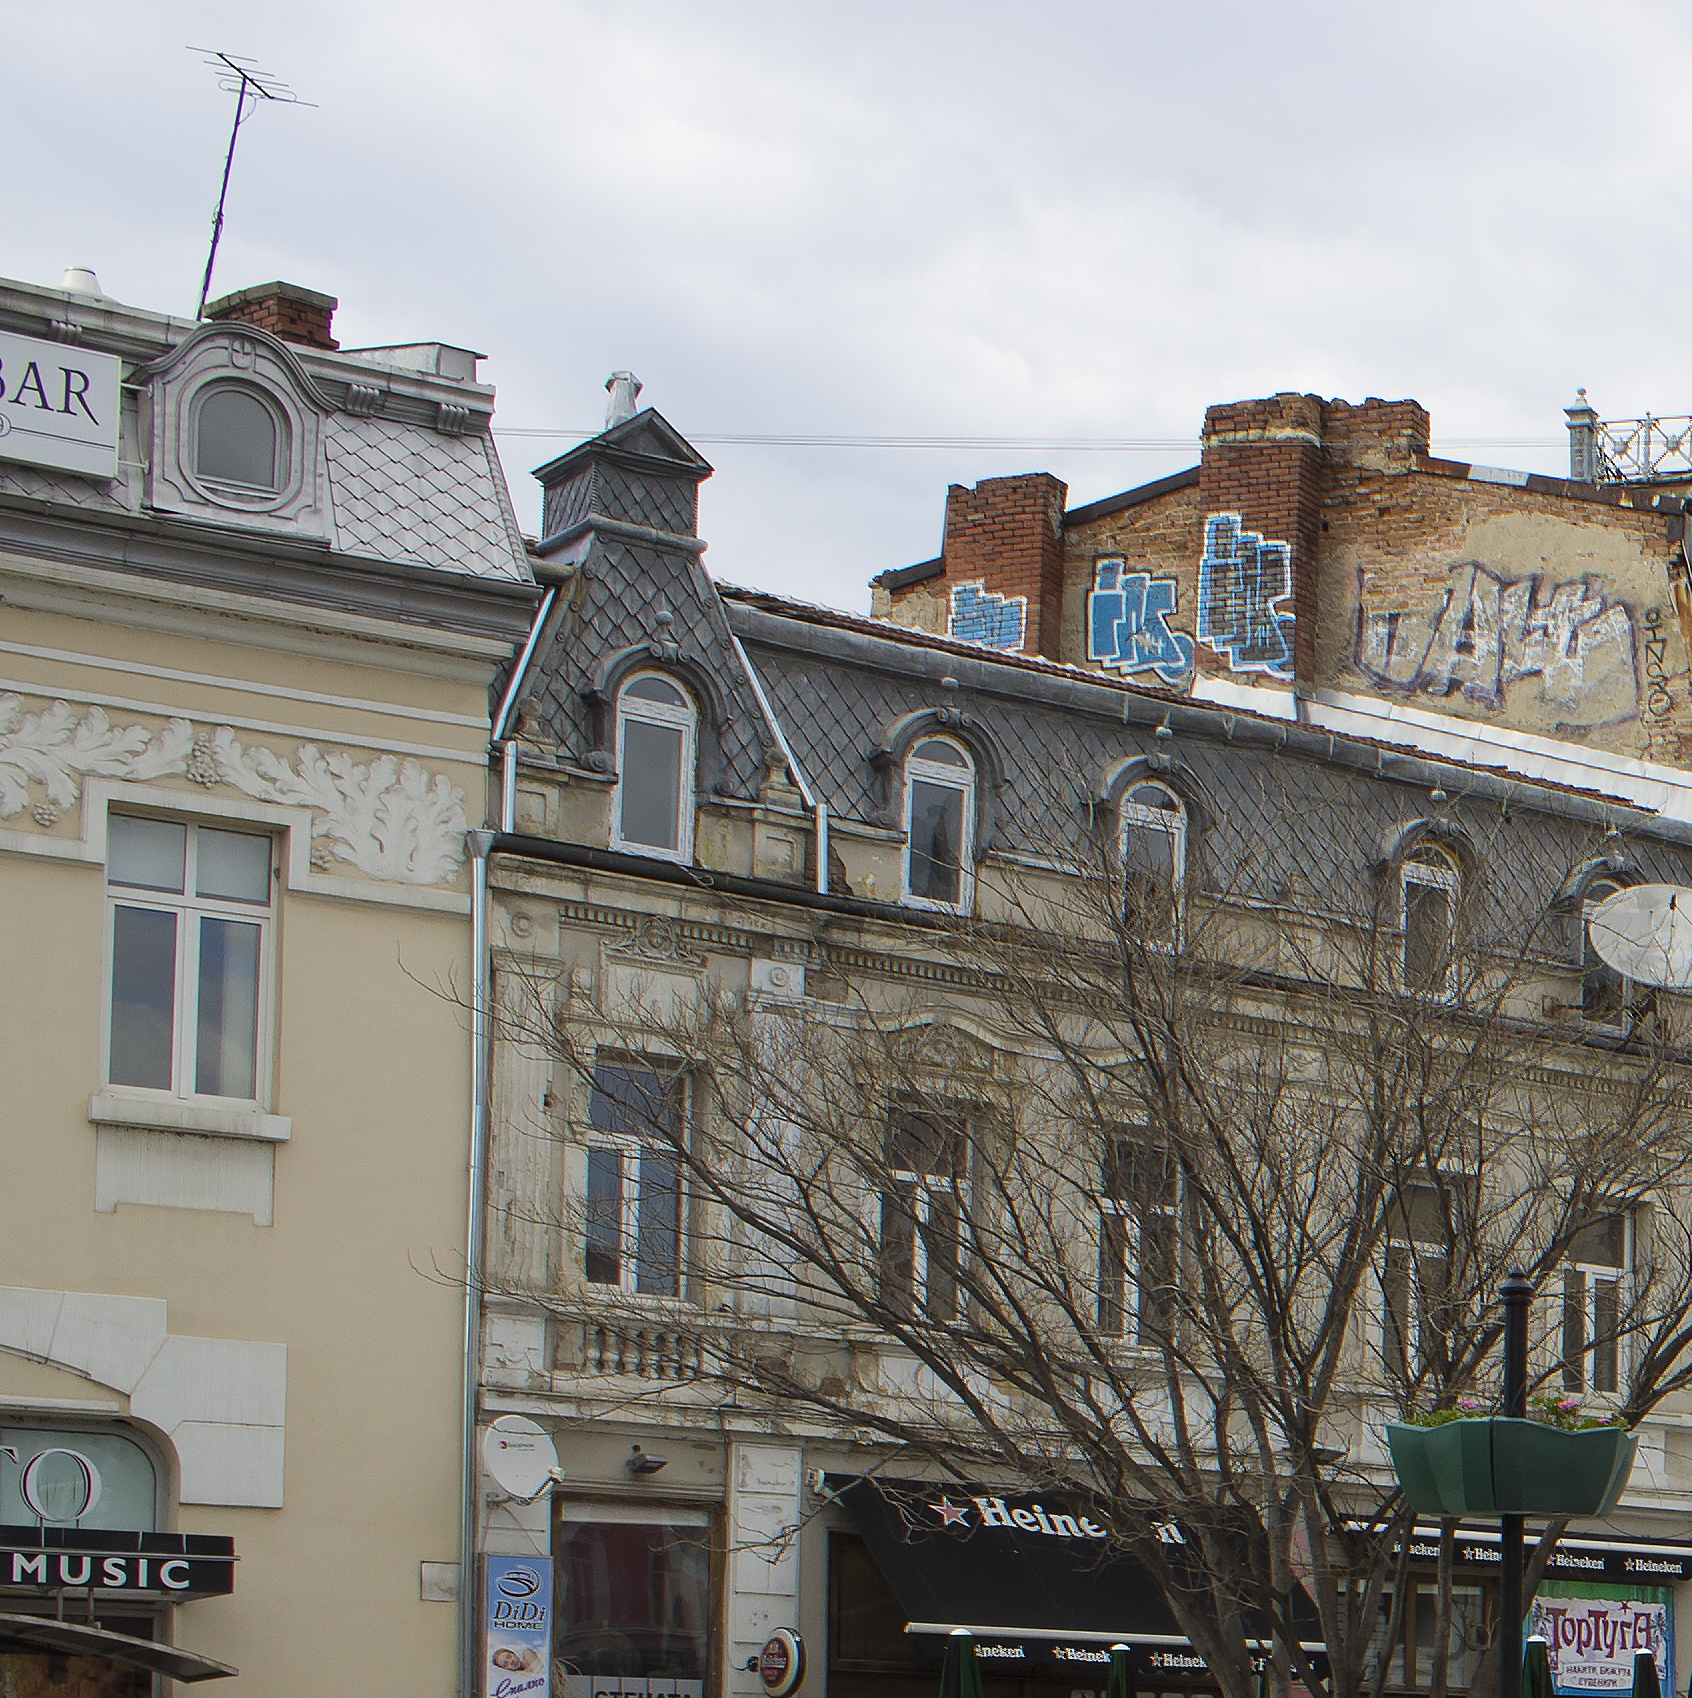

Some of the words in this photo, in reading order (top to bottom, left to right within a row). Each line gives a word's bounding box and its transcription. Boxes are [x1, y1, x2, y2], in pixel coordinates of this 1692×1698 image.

[0, 357, 100, 426] AR
[972, 1497, 1187, 1544] Heinen
[12, 1553, 190, 1589] MUSIC
[1635, 1558, 1683, 1574] Heineken
[493, 1601, 547, 1621] DiDi
[494, 1621, 544, 1630] HOME
[1066, 1647, 1112, 1663] Heinek
